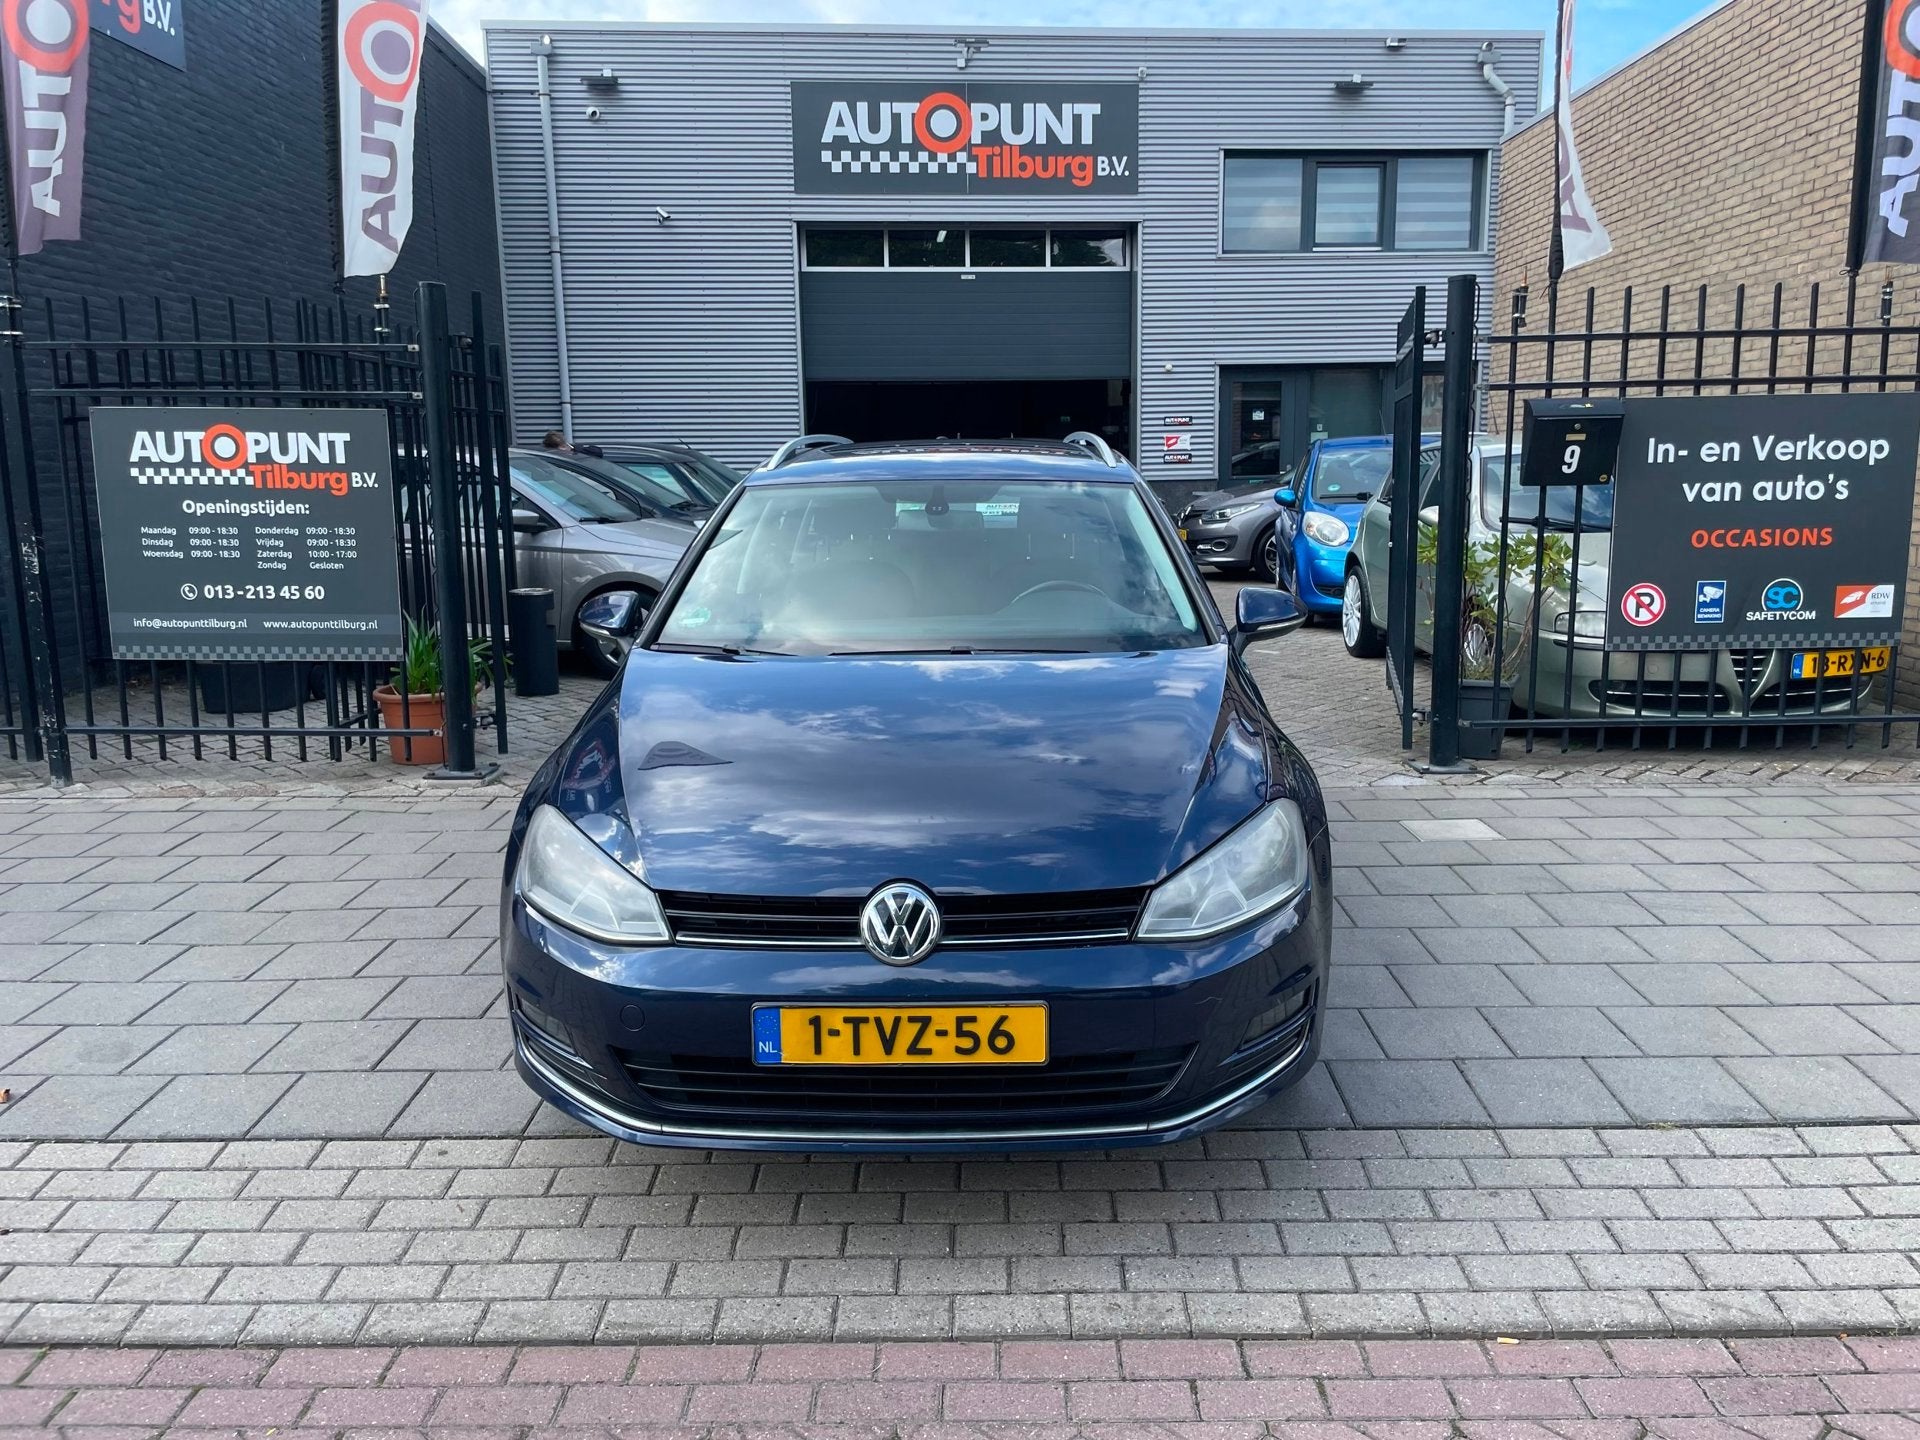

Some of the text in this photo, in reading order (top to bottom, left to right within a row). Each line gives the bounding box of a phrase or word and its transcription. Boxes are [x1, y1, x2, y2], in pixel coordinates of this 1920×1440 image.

[344, 0, 421, 254] AUTO
[821, 92, 1101, 153] AUTOPUNT
[971, 146, 1130, 187] Tilburg B.V.
[130, 423, 350, 470] AUTOPUNT
[1647, 434, 1890, 466] In- en Verkoop
[1561, 445, 1581, 474] 9
[249, 464, 379, 496] Tilburg B.V.
[1682, 473, 1849, 503] van auto's
[182, 500, 310, 516] Openingstijden:
[140, 526, 177, 536] Maandag
[189, 527, 210, 535] 09:00
[217, 527, 238, 535] 18:30
[255, 527, 299, 536] Donderdag
[306, 527, 327, 535] 09:00
[334, 527, 355, 535] 18:30
[1690, 527, 1834, 549] OCCASIONS
[142, 538, 173, 548] Dinsdag
[190, 538, 211, 547] 09:00
[218, 538, 239, 547] 18:30
[256, 538, 284, 548] Vrijdag
[307, 539, 328, 547] 09:00
[335, 539, 356, 547] 18:30
[143, 550, 184, 559] Woensdag
[191, 550, 212, 558] 09:00
[219, 550, 240, 558] 18:30
[257, 550, 292, 559] Zaterdag
[257, 561, 344, 570] Zondag Gesloten
[280, 585, 300, 599] 45
[304, 585, 325, 600] 60
[1871, 592, 1890, 600] RDW
[1746, 611, 1816, 621] SAFETYCOM
[133, 618, 378, 632] info@autopunttilburg.nl www.autopunttilburg.nl
[808, 1014, 1016, 1056] 1-TVZ-56
[758, 1041, 778, 1054] NL
